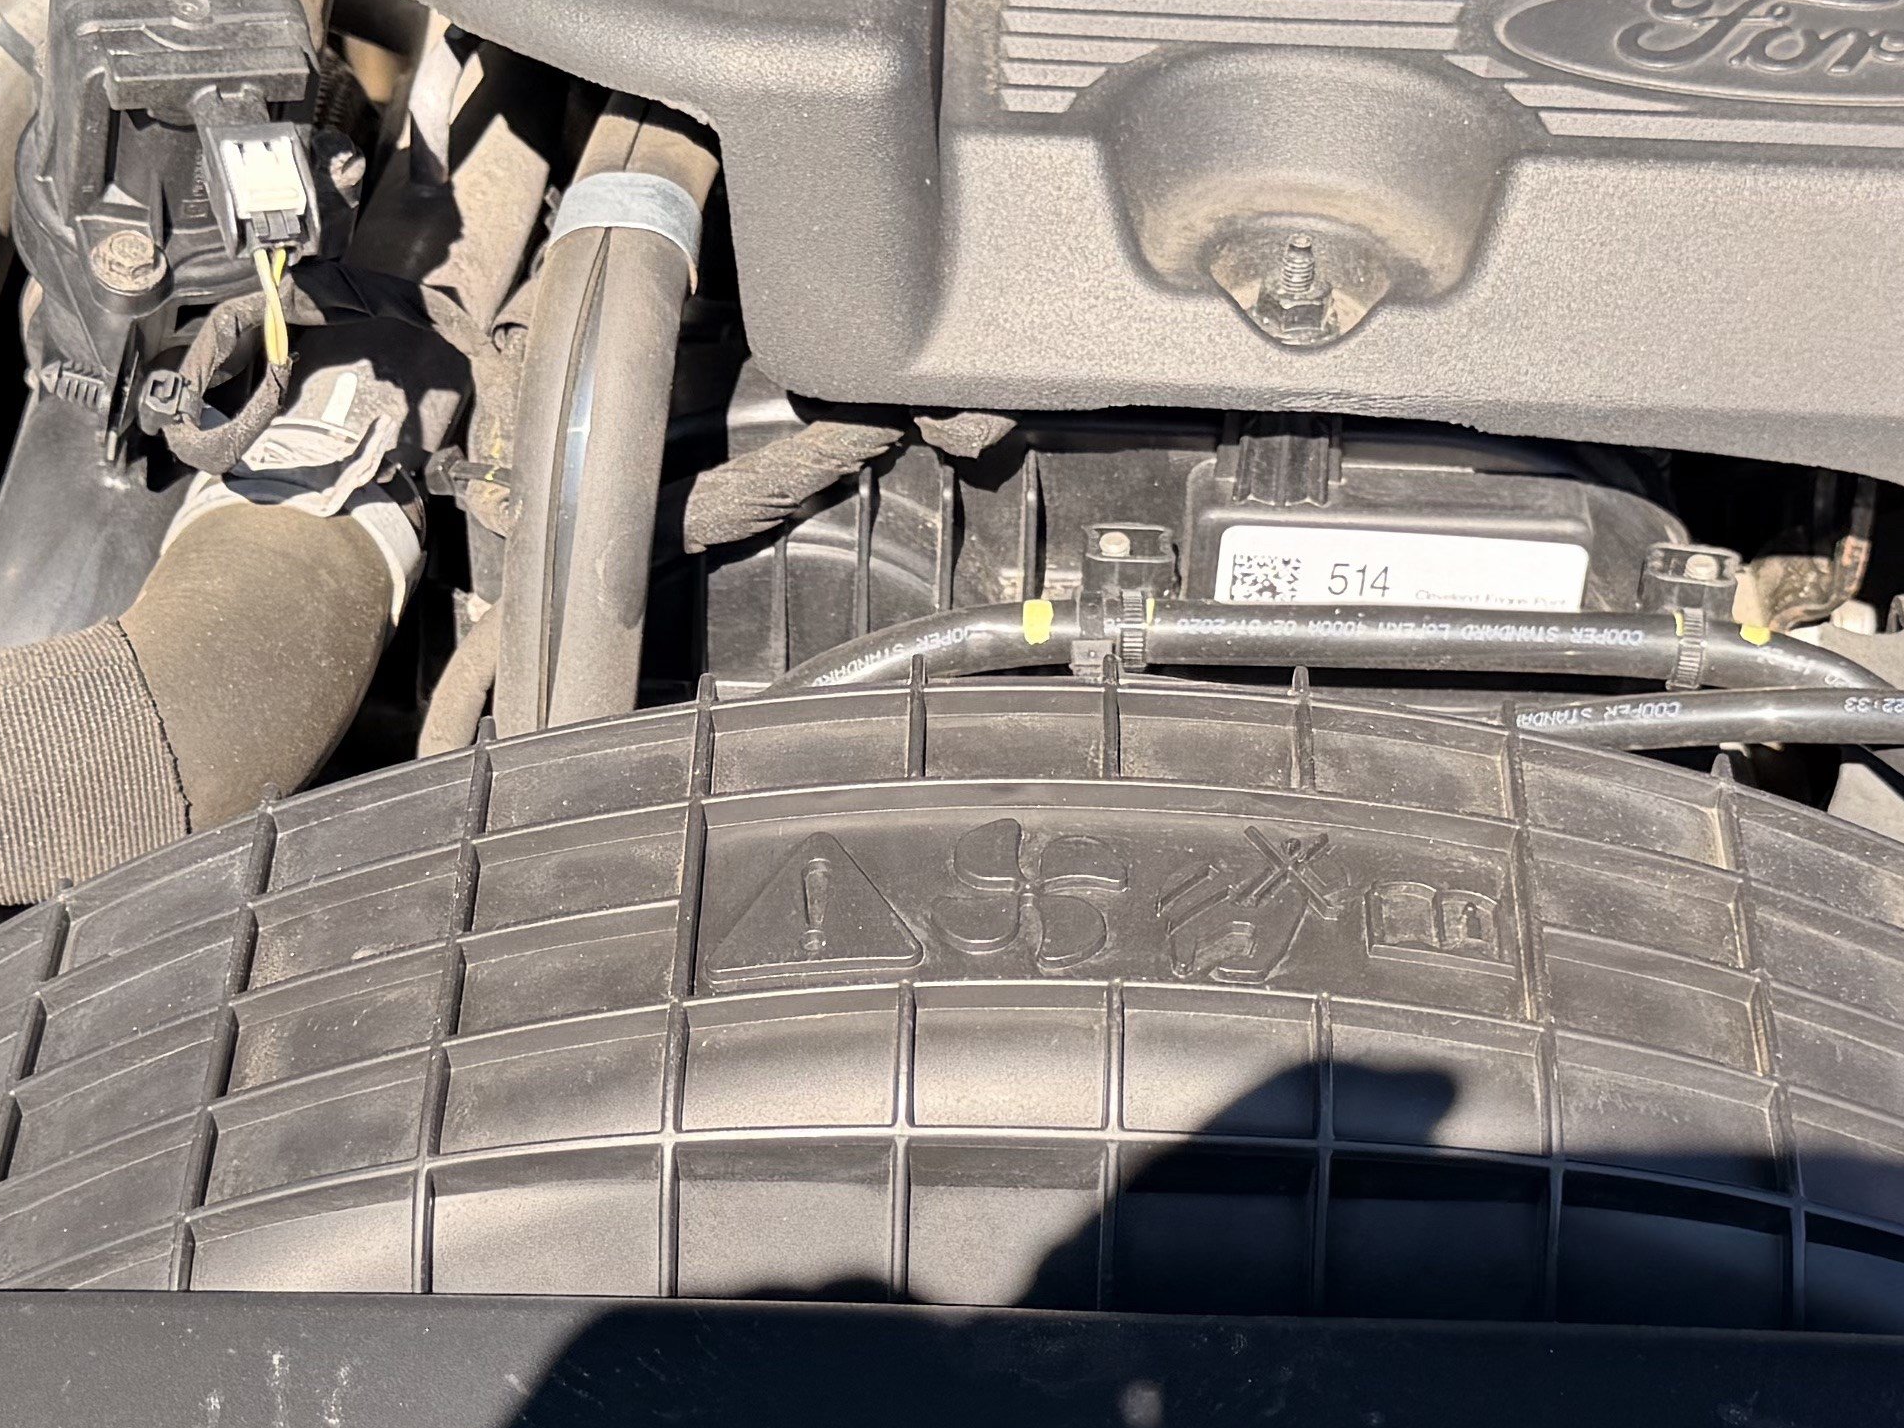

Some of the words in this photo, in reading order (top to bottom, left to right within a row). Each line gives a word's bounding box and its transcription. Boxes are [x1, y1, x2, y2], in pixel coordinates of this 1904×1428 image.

[1326, 560, 1391, 600] 514
[1459, 621, 1560, 645] STANDARD
[1570, 623, 1645, 649] COOPER
[1602, 700, 1682, 720] COOPER
